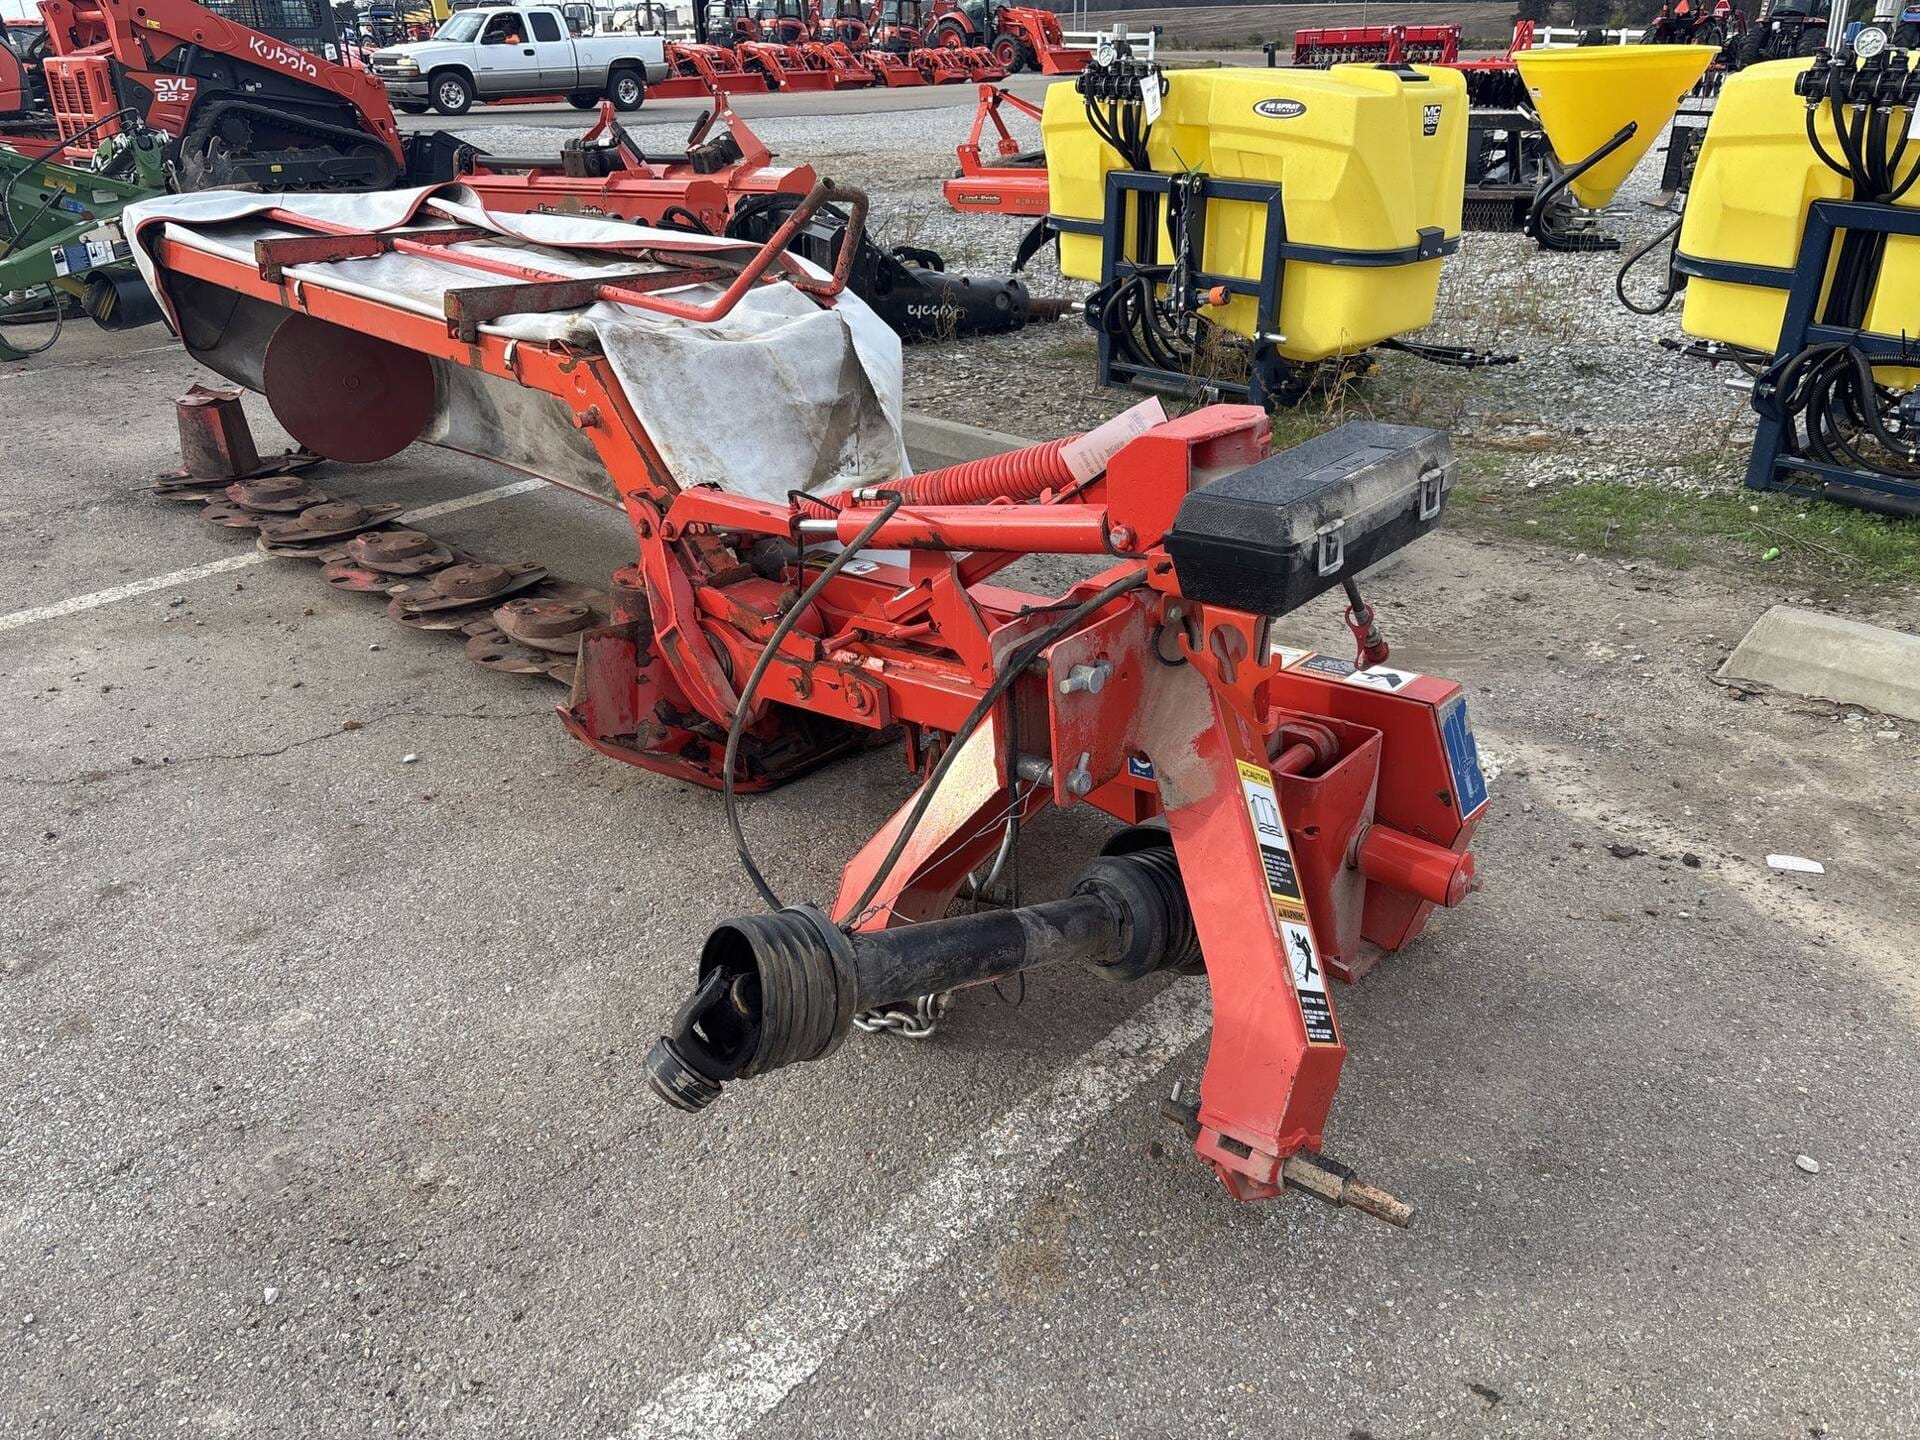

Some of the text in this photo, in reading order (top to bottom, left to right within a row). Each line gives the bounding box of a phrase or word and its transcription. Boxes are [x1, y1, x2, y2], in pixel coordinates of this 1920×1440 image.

[249, 36, 318, 78] Kubota
[154, 78, 195, 91] SVL
[157, 91, 190, 102] 65-2
[1424, 106, 1441, 117] MC
[1246, 768, 1271, 784] CAUTION
[1282, 908, 1306, 922] WARNING
